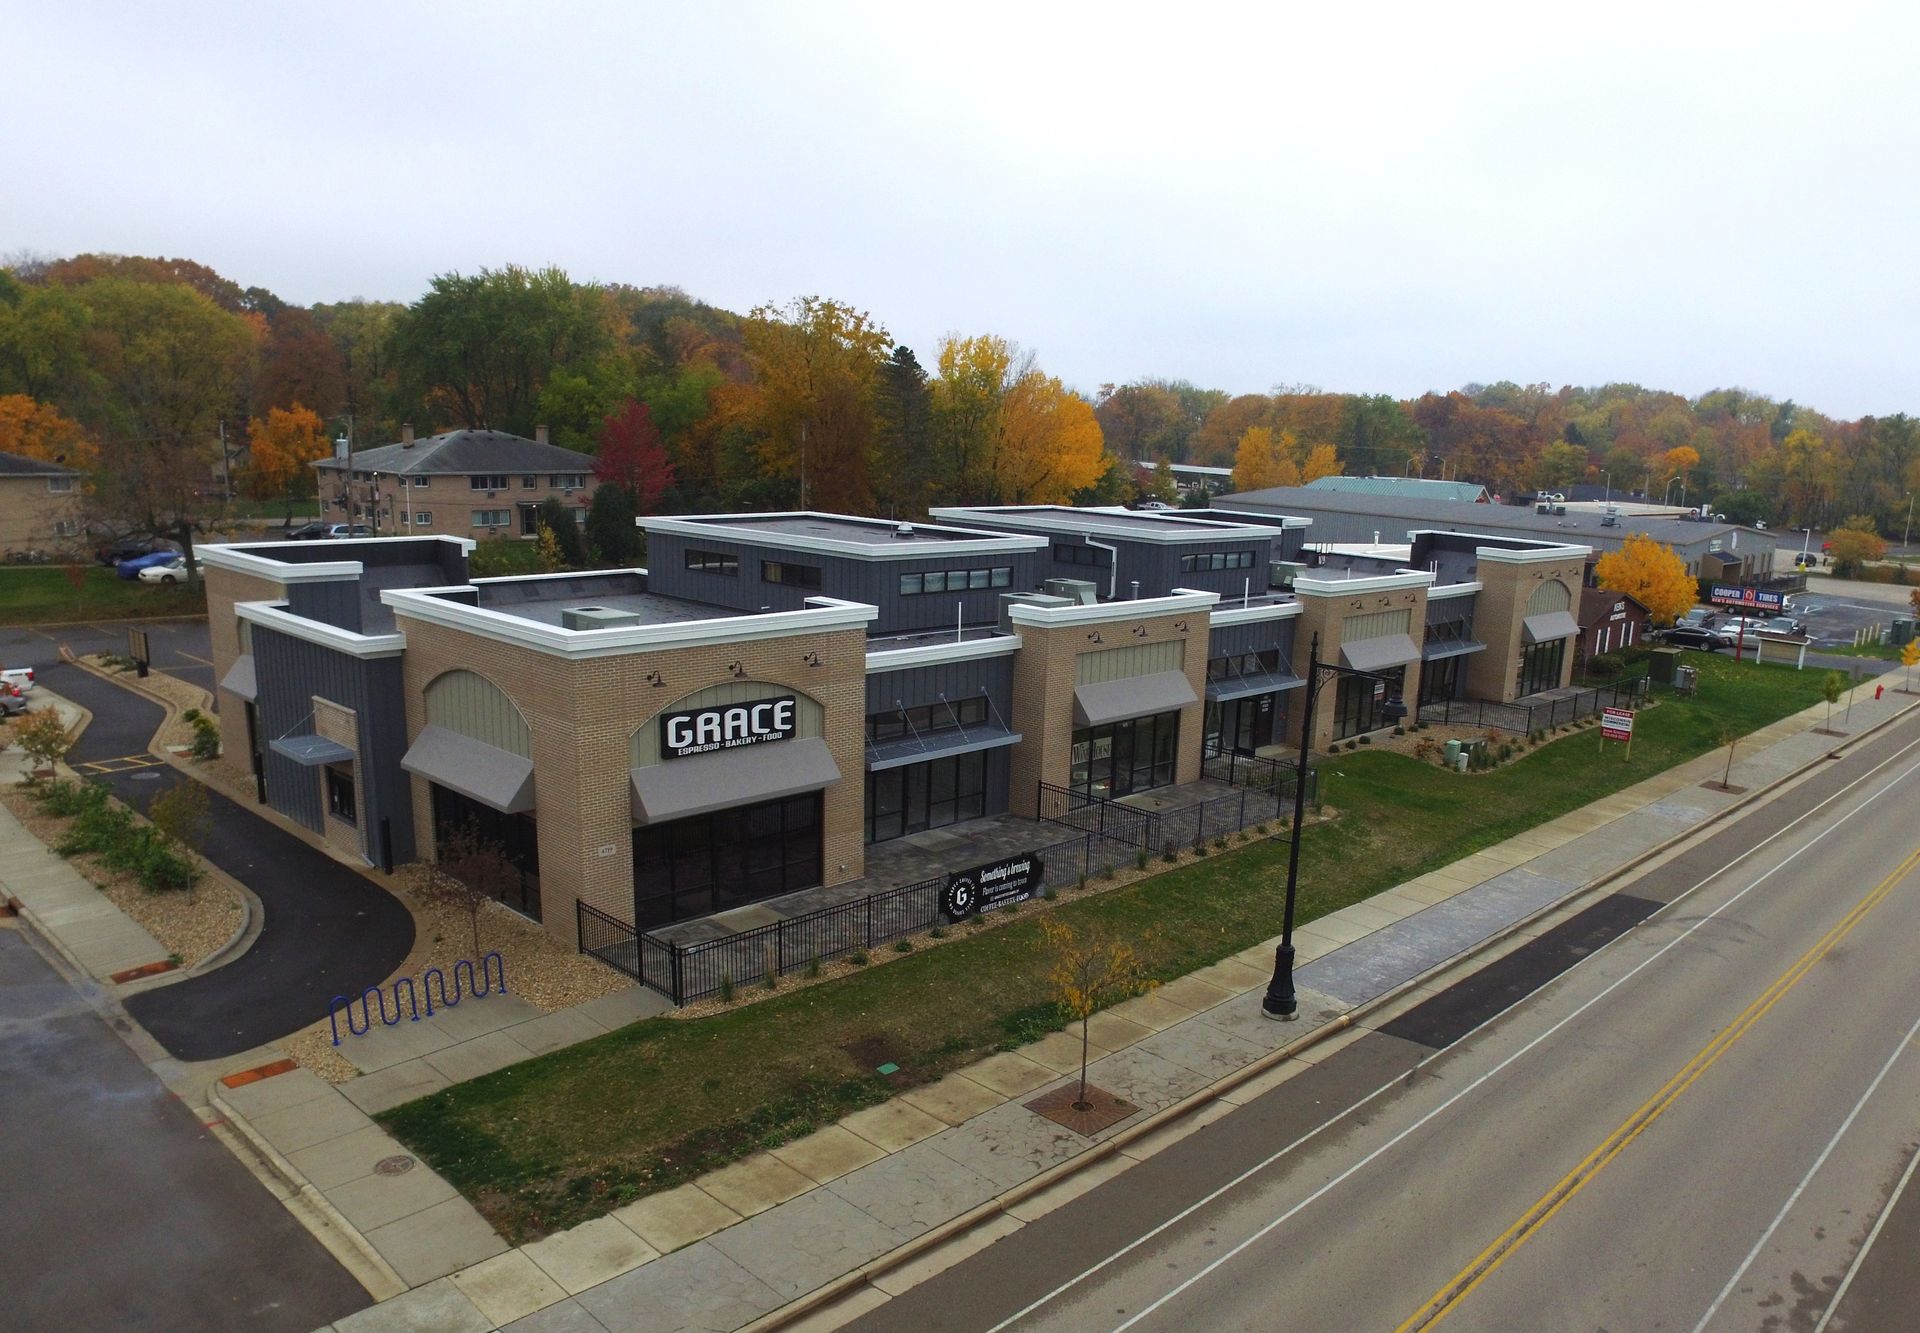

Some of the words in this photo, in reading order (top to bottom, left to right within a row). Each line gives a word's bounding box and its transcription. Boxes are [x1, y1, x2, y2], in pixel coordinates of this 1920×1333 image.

[1714, 587, 1740, 598] COOPER
[1759, 593, 1779, 603] TIRES
[667, 700, 795, 748] GRACE
[678, 742, 720, 756] ESPRESSO
[725, 736, 758, 748] BAKERY
[763, 731, 783, 742] FOOD
[980, 863, 1011, 884] Something's
[1010, 860, 1031, 874] brewing
[956, 886, 968, 906] G
